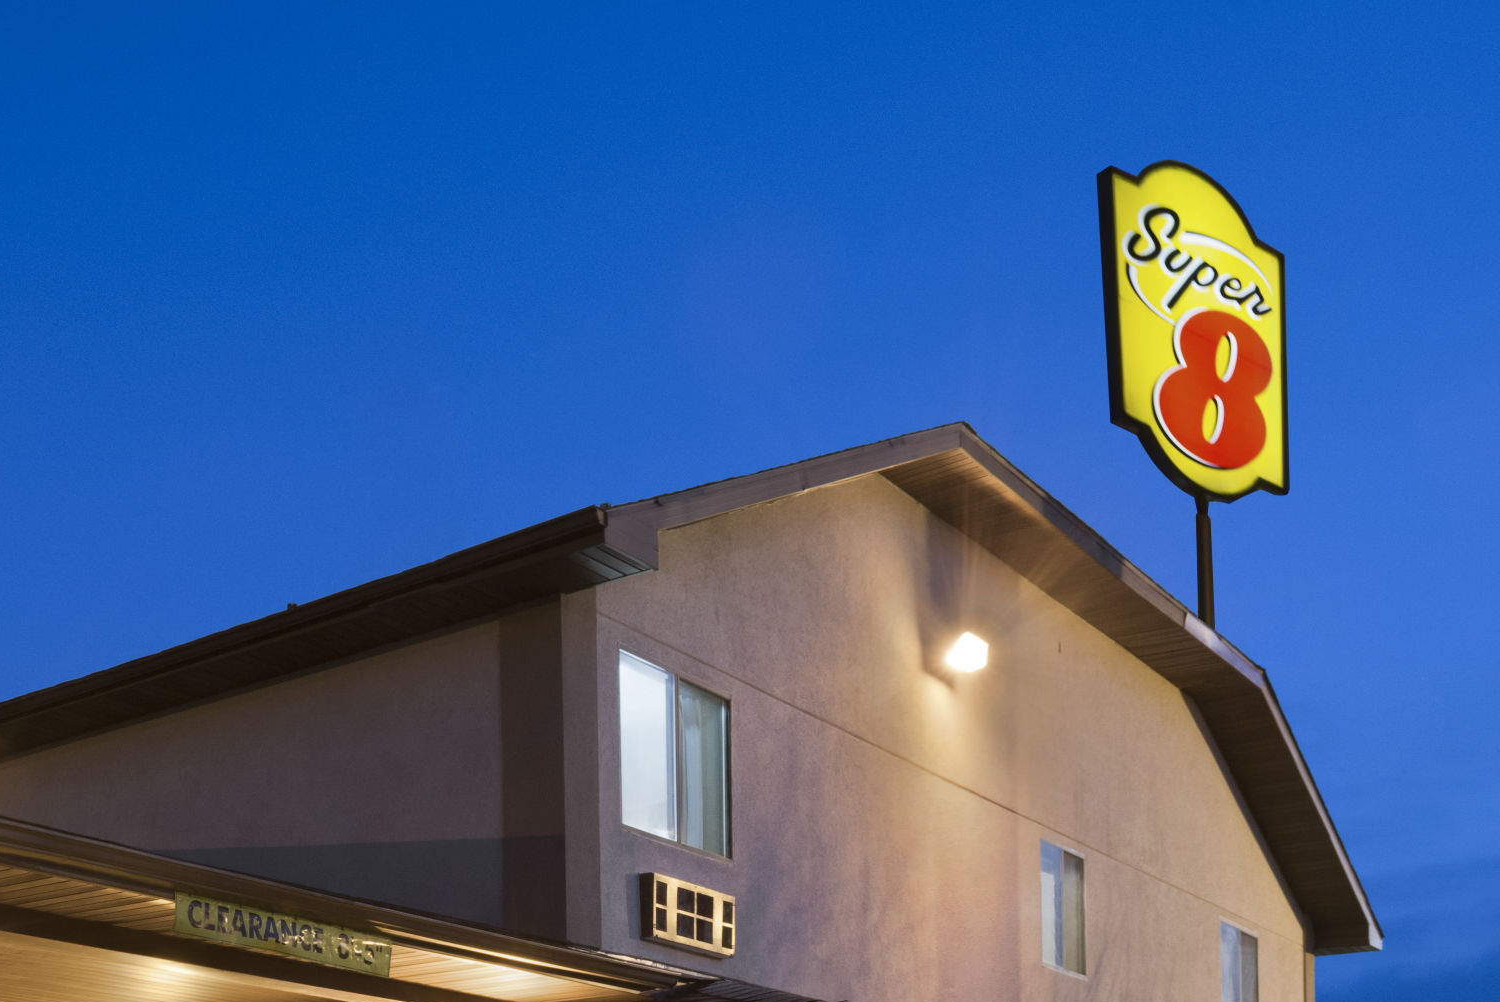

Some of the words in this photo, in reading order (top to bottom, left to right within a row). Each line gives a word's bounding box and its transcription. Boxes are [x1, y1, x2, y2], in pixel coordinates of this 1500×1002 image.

[1123, 204, 1272, 319] Super
[1153, 307, 1273, 469] 8
[187, 899, 325, 954] CLEARANCE
